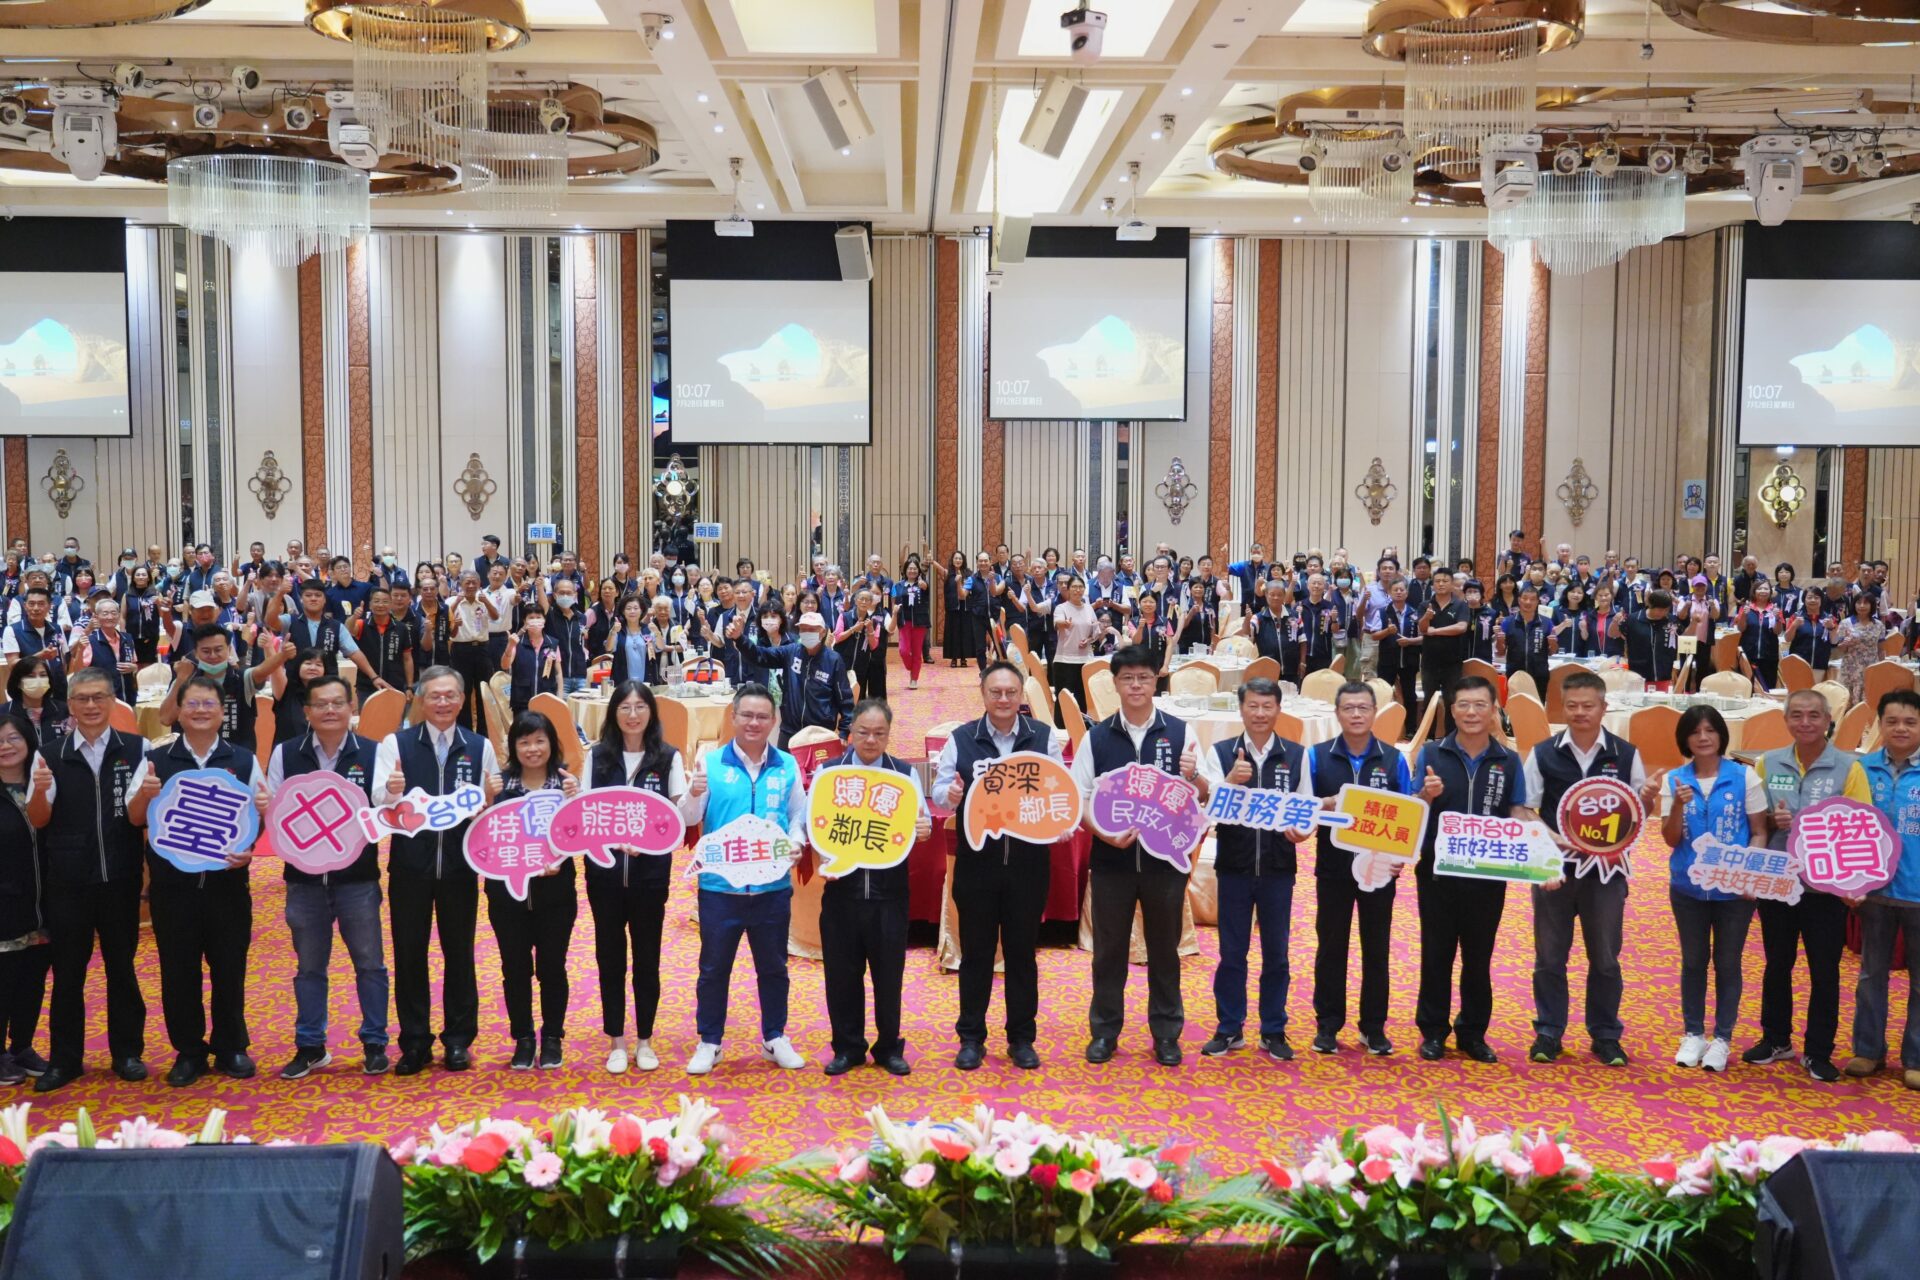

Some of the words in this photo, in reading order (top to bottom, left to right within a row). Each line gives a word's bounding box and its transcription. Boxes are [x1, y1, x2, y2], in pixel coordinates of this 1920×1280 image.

[676, 384, 711, 398] 10:07
[996, 380, 1030, 395] 10:07
[1747, 385, 1783, 399] 10:07
[530, 527, 553, 539] 南區
[695, 526, 721, 538] 南區
[977, 761, 1041, 795] 資深
[1127, 765, 1198, 814] 績優
[832, 775, 903, 819] 績優
[1019, 793, 1073, 824] 鄰長
[1208, 786, 1353, 830] 服務第一
[1364, 800, 1399, 821] 績優
[1578, 793, 1621, 817] 台中
[157, 780, 248, 861] 臺
[280, 786, 354, 854] 中
[360, 812, 379, 839] i
[427, 788, 483, 828] 台中
[488, 792, 564, 843] 特優
[581, 801, 649, 837] 熊讚
[1112, 799, 1190, 850] 民政人員
[1442, 815, 1524, 839] 富市台中
[1579, 813, 1622, 844] No.1
[829, 813, 892, 853] 鄰長
[1803, 811, 1890, 883] 讚
[497, 843, 546, 868] 里長
[1448, 836, 1529, 863] 新好生活
[1701, 847, 1788, 874] 臺中優里
[1706, 868, 1795, 897] 共好有鄰
